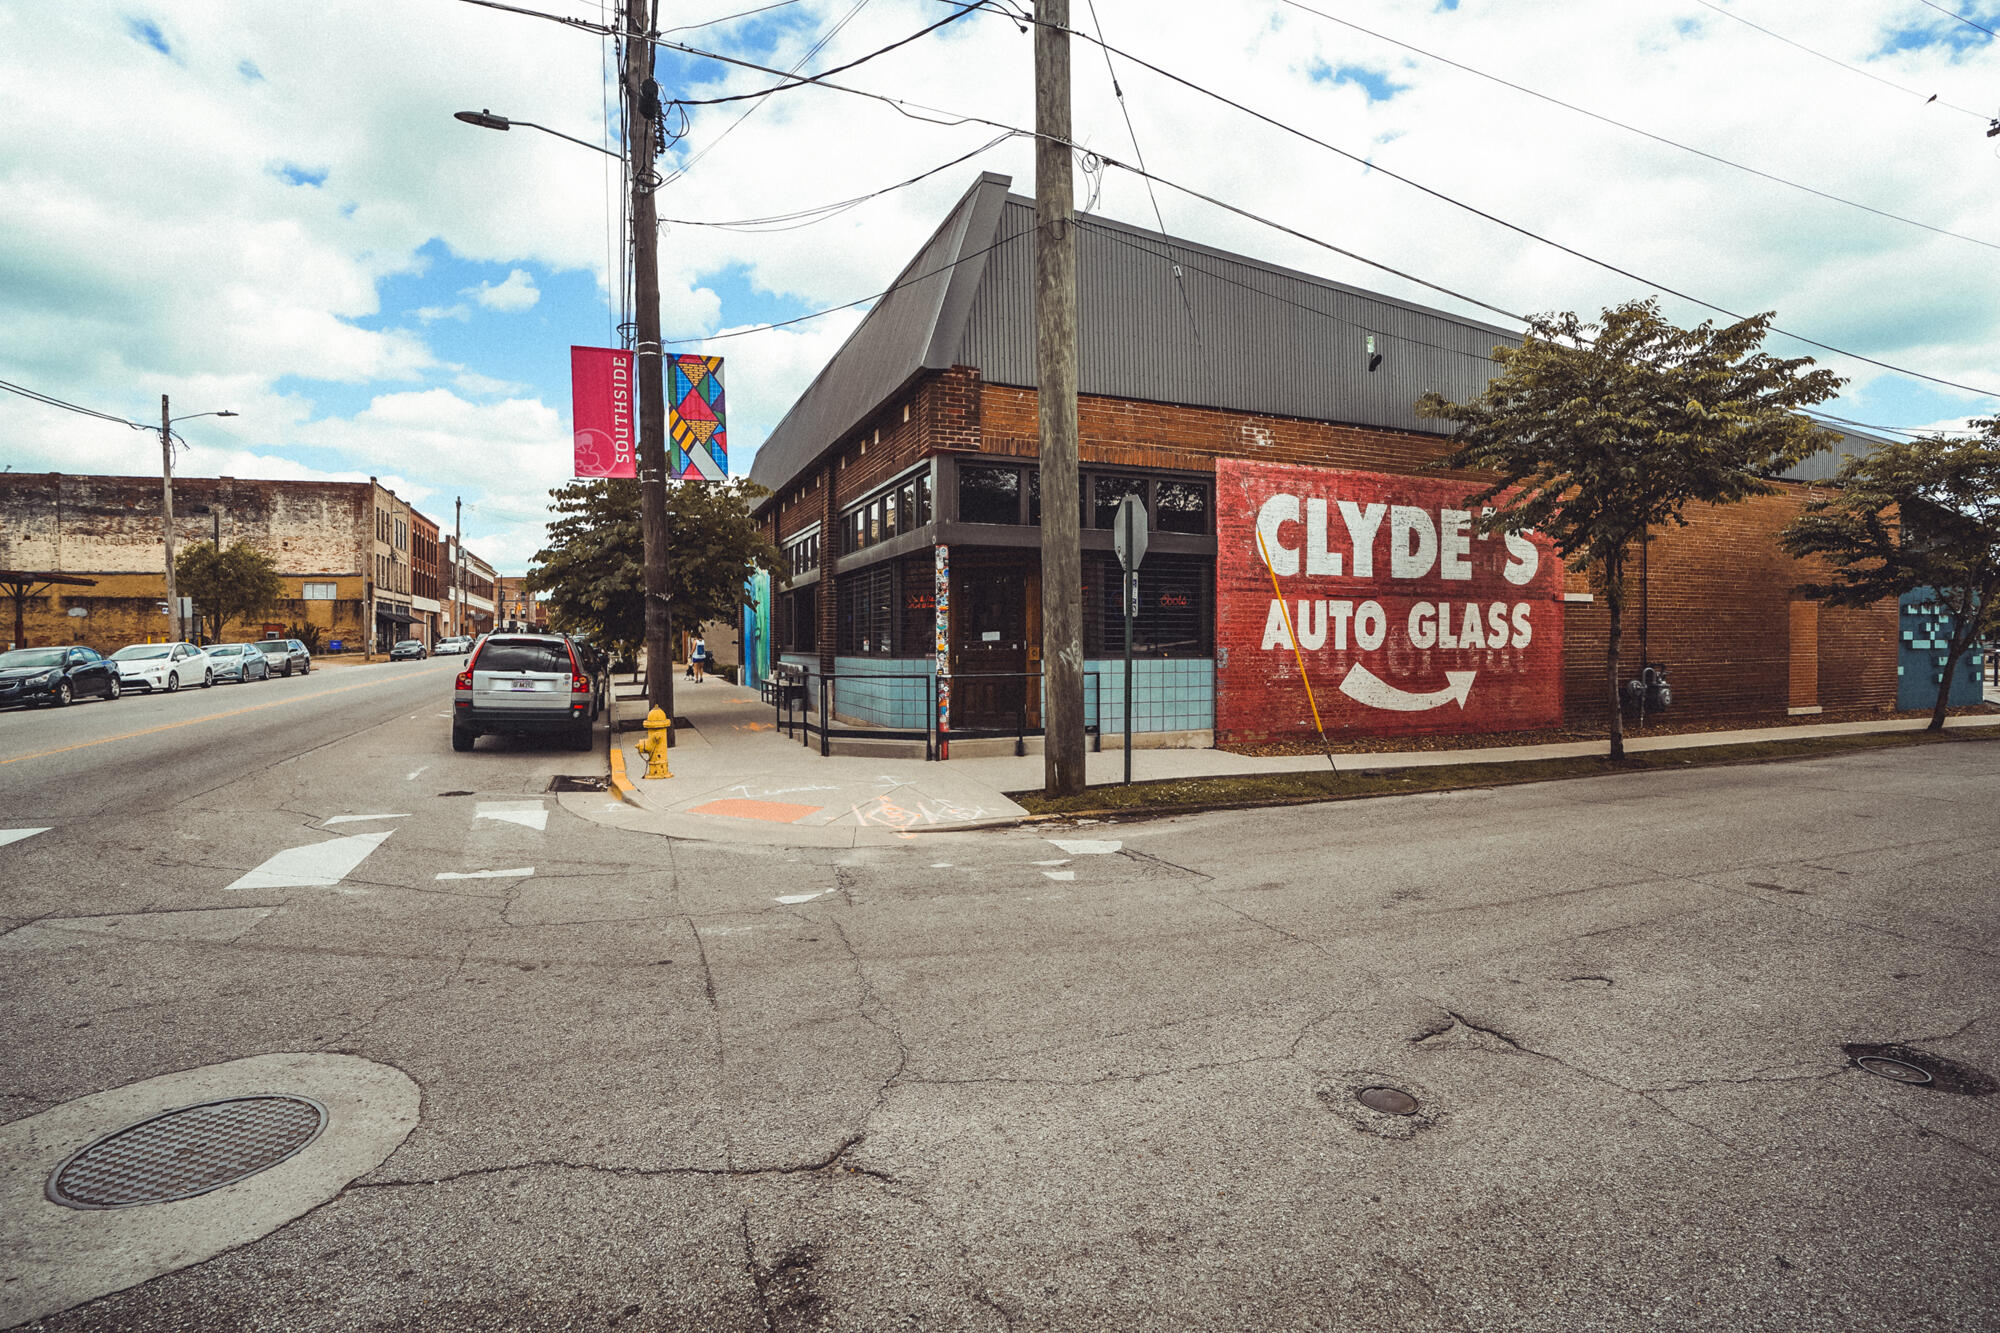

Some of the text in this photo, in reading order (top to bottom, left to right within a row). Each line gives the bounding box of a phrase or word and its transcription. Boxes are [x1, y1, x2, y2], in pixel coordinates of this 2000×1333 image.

[613, 357, 630, 463] SOUTHSIDE
[1256, 493, 1538, 585] CLYDE'S
[1261, 599, 1533, 651] AUTO GLASS
